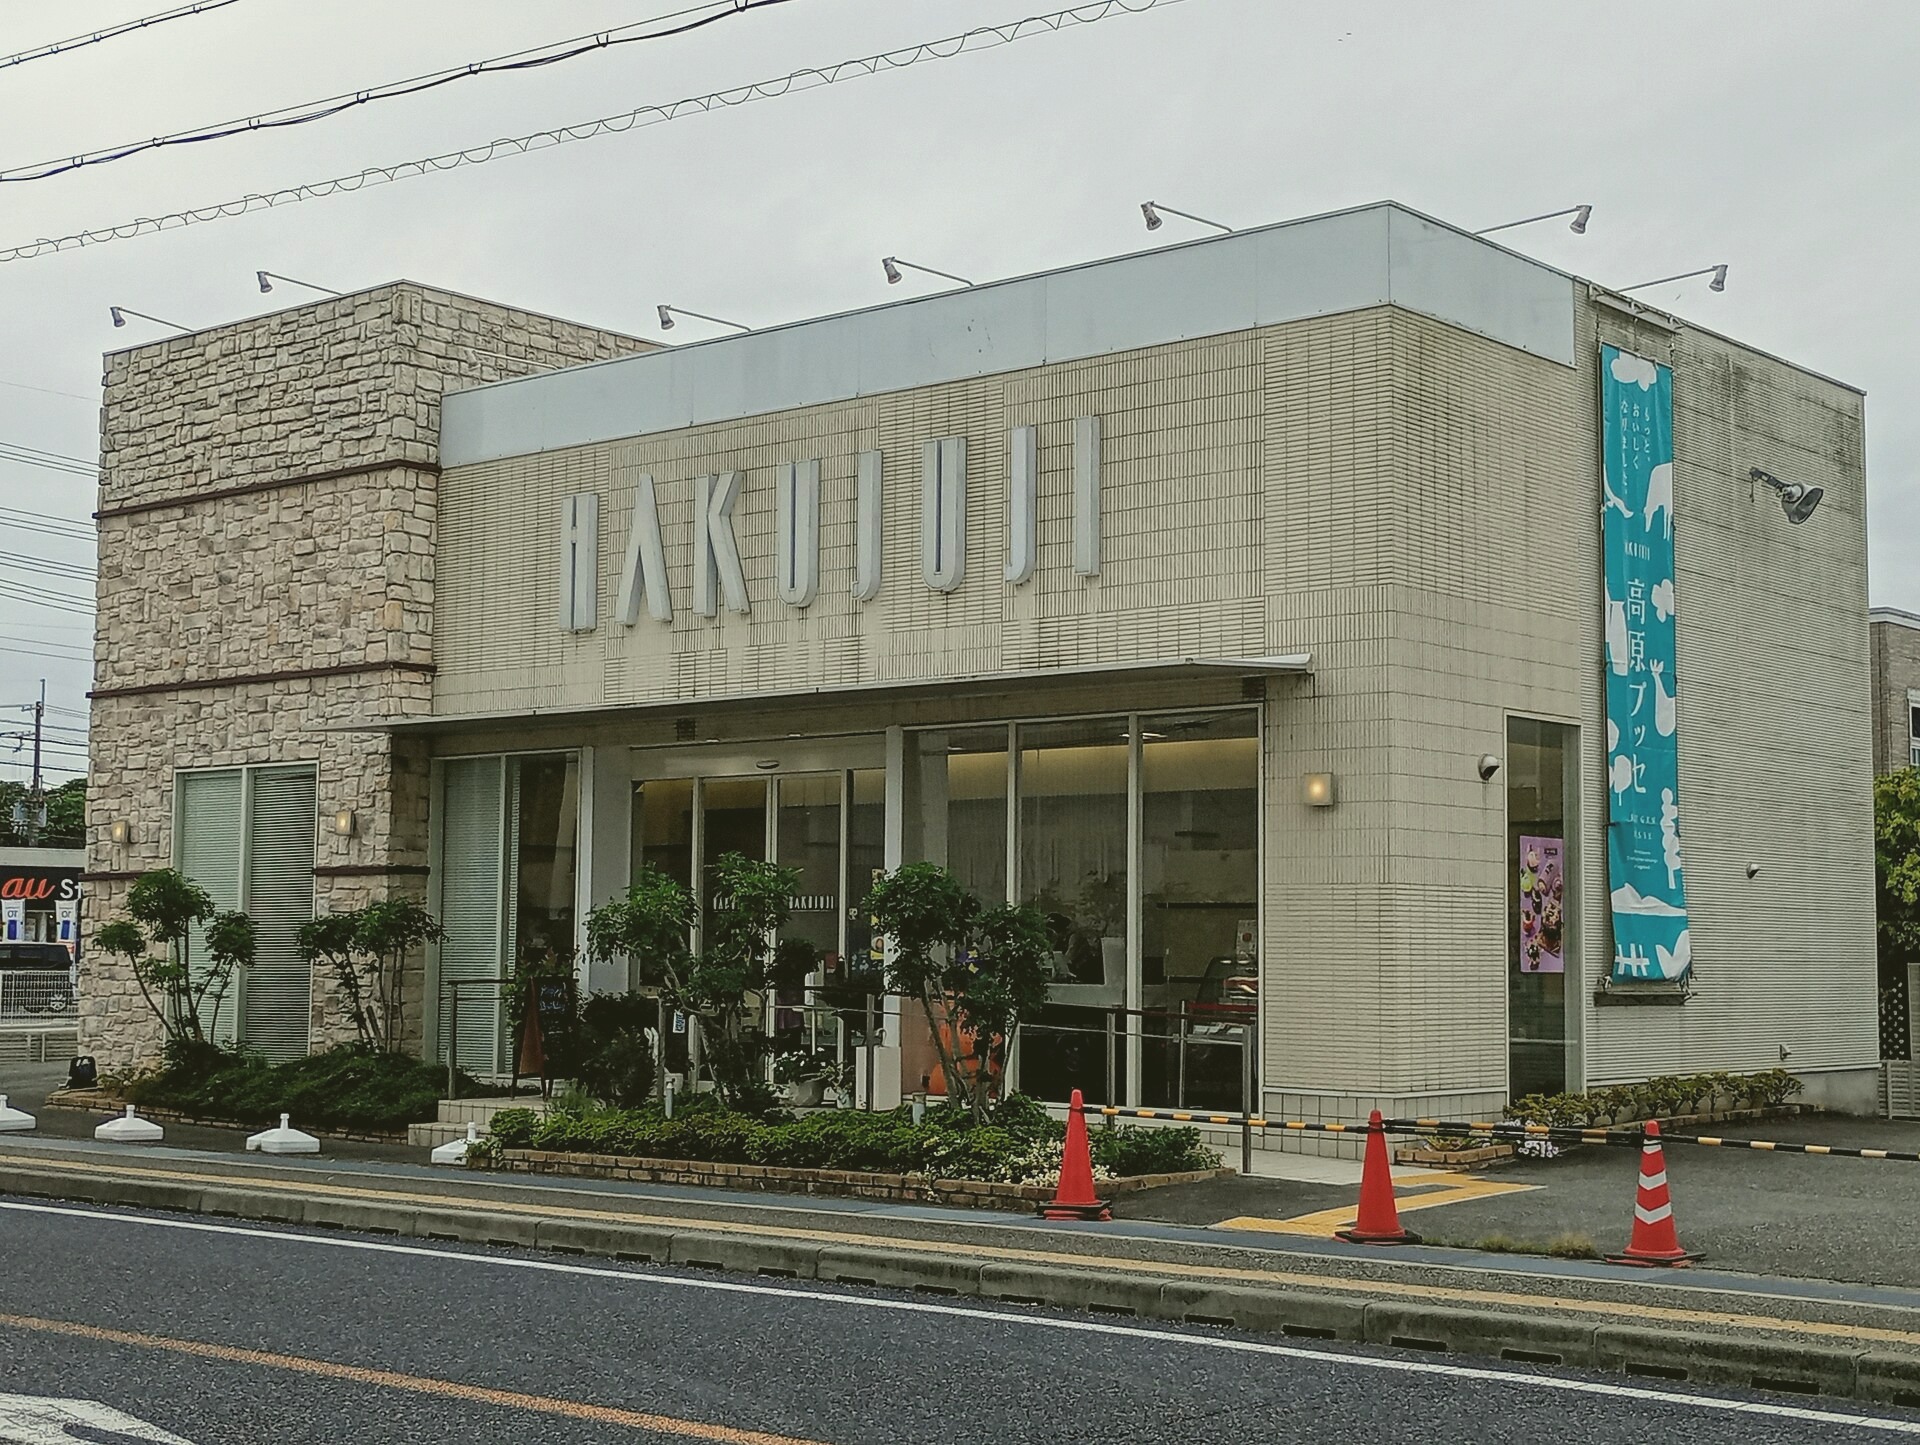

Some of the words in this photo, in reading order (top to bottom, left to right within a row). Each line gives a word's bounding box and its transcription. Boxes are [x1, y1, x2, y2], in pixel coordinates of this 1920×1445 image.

[1632, 403, 1640, 470] おいしく
[559, 415, 1100, 633] HAKUJUJI
[1, 877, 55, 899] au
